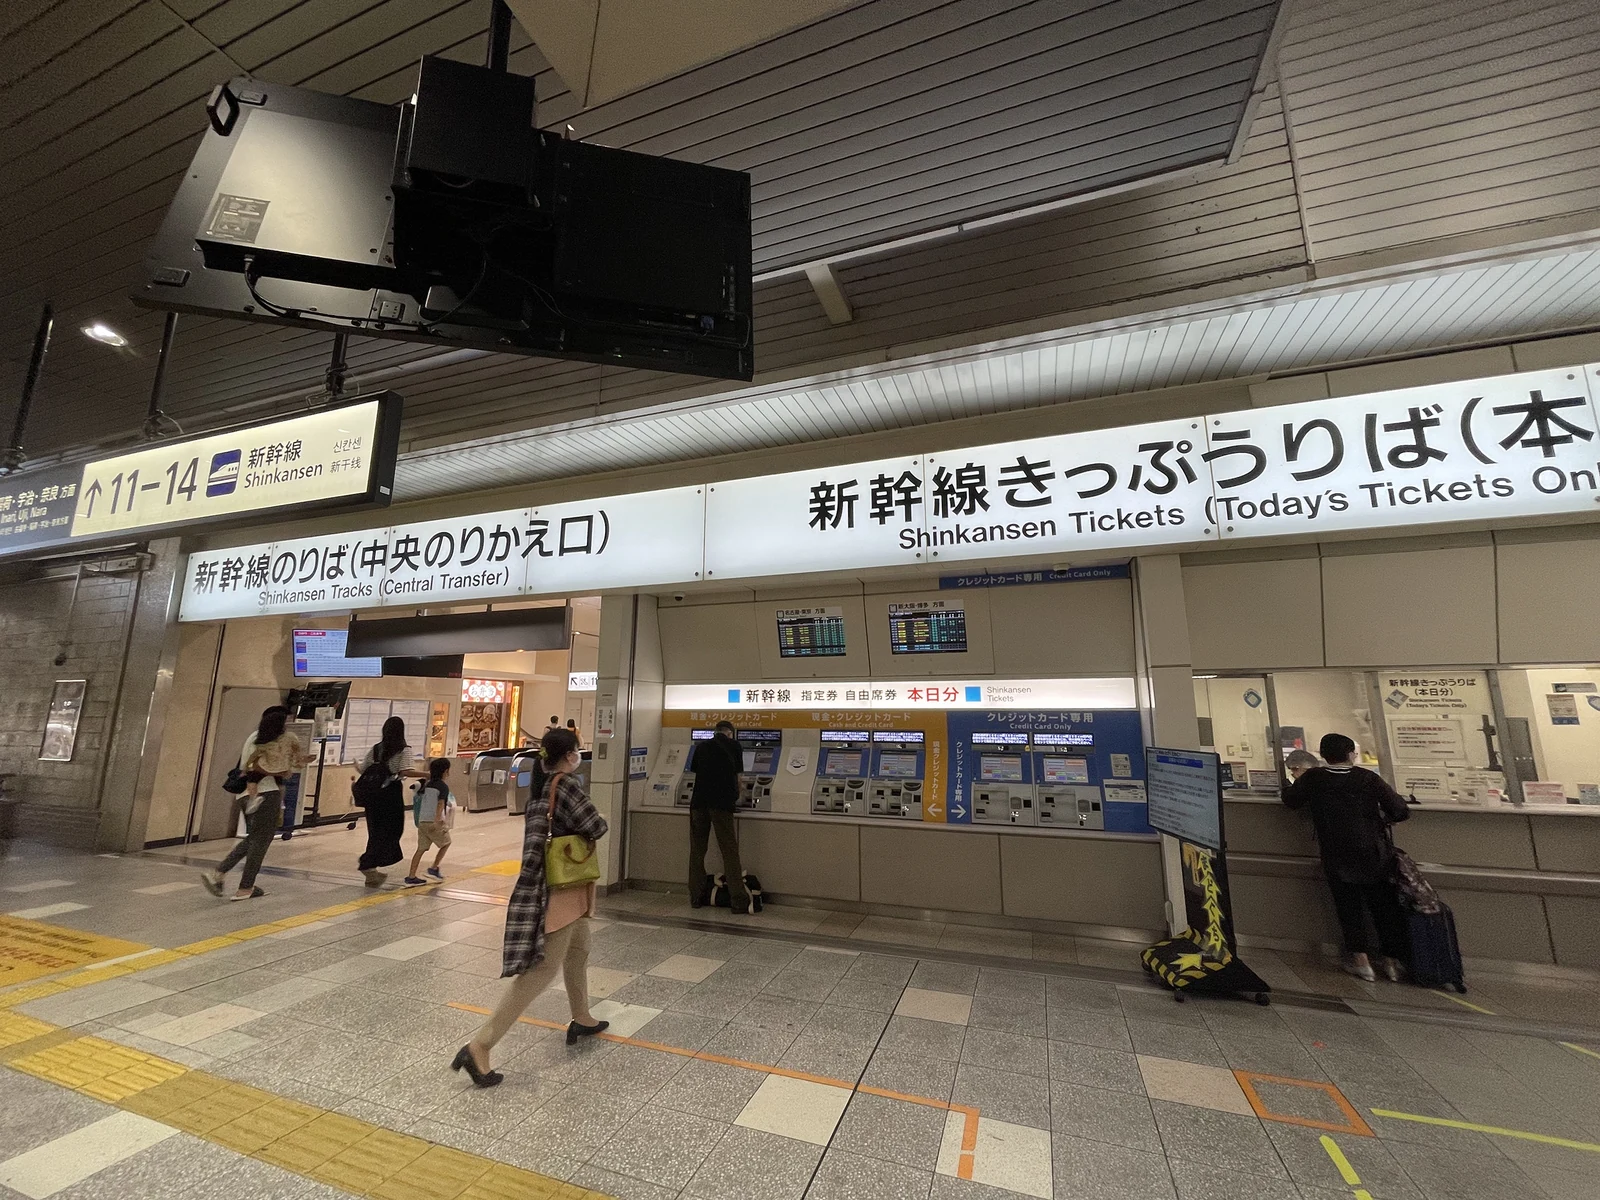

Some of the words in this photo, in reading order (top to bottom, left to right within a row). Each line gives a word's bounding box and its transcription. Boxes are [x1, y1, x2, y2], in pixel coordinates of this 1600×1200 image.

[333, 436, 362, 454] 신칸센
[248, 439, 303, 469] 新幹線
[330, 455, 362, 474] 新干线
[244, 462, 323, 489] Shinkansen
[60, 483, 77, 499] 方面
[111, 457, 200, 515] 11-14
[30, 507, 48, 518] Nara
[899, 517, 1057, 551] Shinkansen
[1069, 504, 1185, 534] Tickets
[1204, 489, 1350, 525] (Today's
[1359, 473, 1515, 508] Tickets
[193, 510, 610, 595] 新幹線のりば(中央のりかえ口)
[957, 573, 1043, 587] クレジットカード専用
[1093, 569, 1111, 577] Only
[258, 589, 326, 607] Shinkansen
[332, 583, 373, 600] Tracks
[378, 575, 434, 596] (Central
[440, 566, 509, 590] Transfer)
[986, 686, 1032, 694] Shinkansen
[1389, 678, 1476, 687] 新幹線きっぷうりば
[746, 688, 791, 703] 新幹線
[801, 689, 838, 701] 指定券
[845, 689, 897, 701] 自由席券
[907, 686, 959, 703] 本日分
[987, 694, 1014, 703] Tickets
[1414, 688, 1454, 696] (本日分)
[811, 712, 911, 722] 現金・クレジットカード
[987, 712, 1094, 723] クレジットカード専用
[1053, 723, 1071, 731] Only
